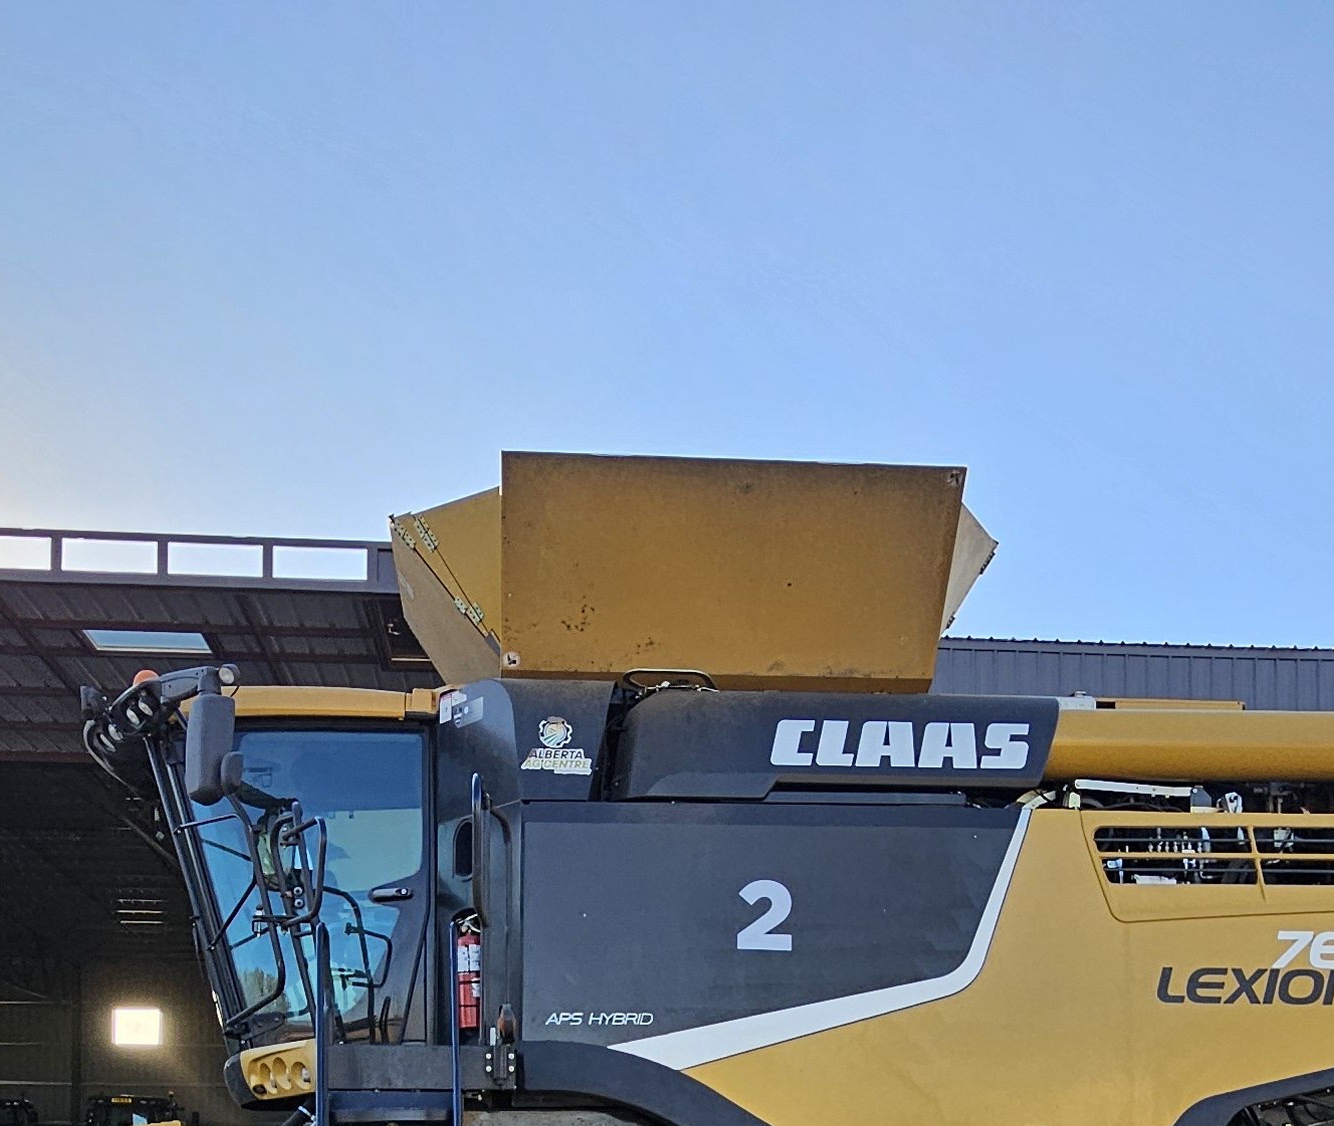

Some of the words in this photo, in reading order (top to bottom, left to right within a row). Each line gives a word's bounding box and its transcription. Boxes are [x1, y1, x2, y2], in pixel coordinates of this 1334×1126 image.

[770, 719, 1030, 769] CLAAS
[529, 749, 584, 759] ALBERTA
[543, 759, 590, 769] CENTRE
[736, 879, 793, 951] 2
[545, 1012, 584, 1026] APS
[588, 1012, 654, 1026] HYBRID
